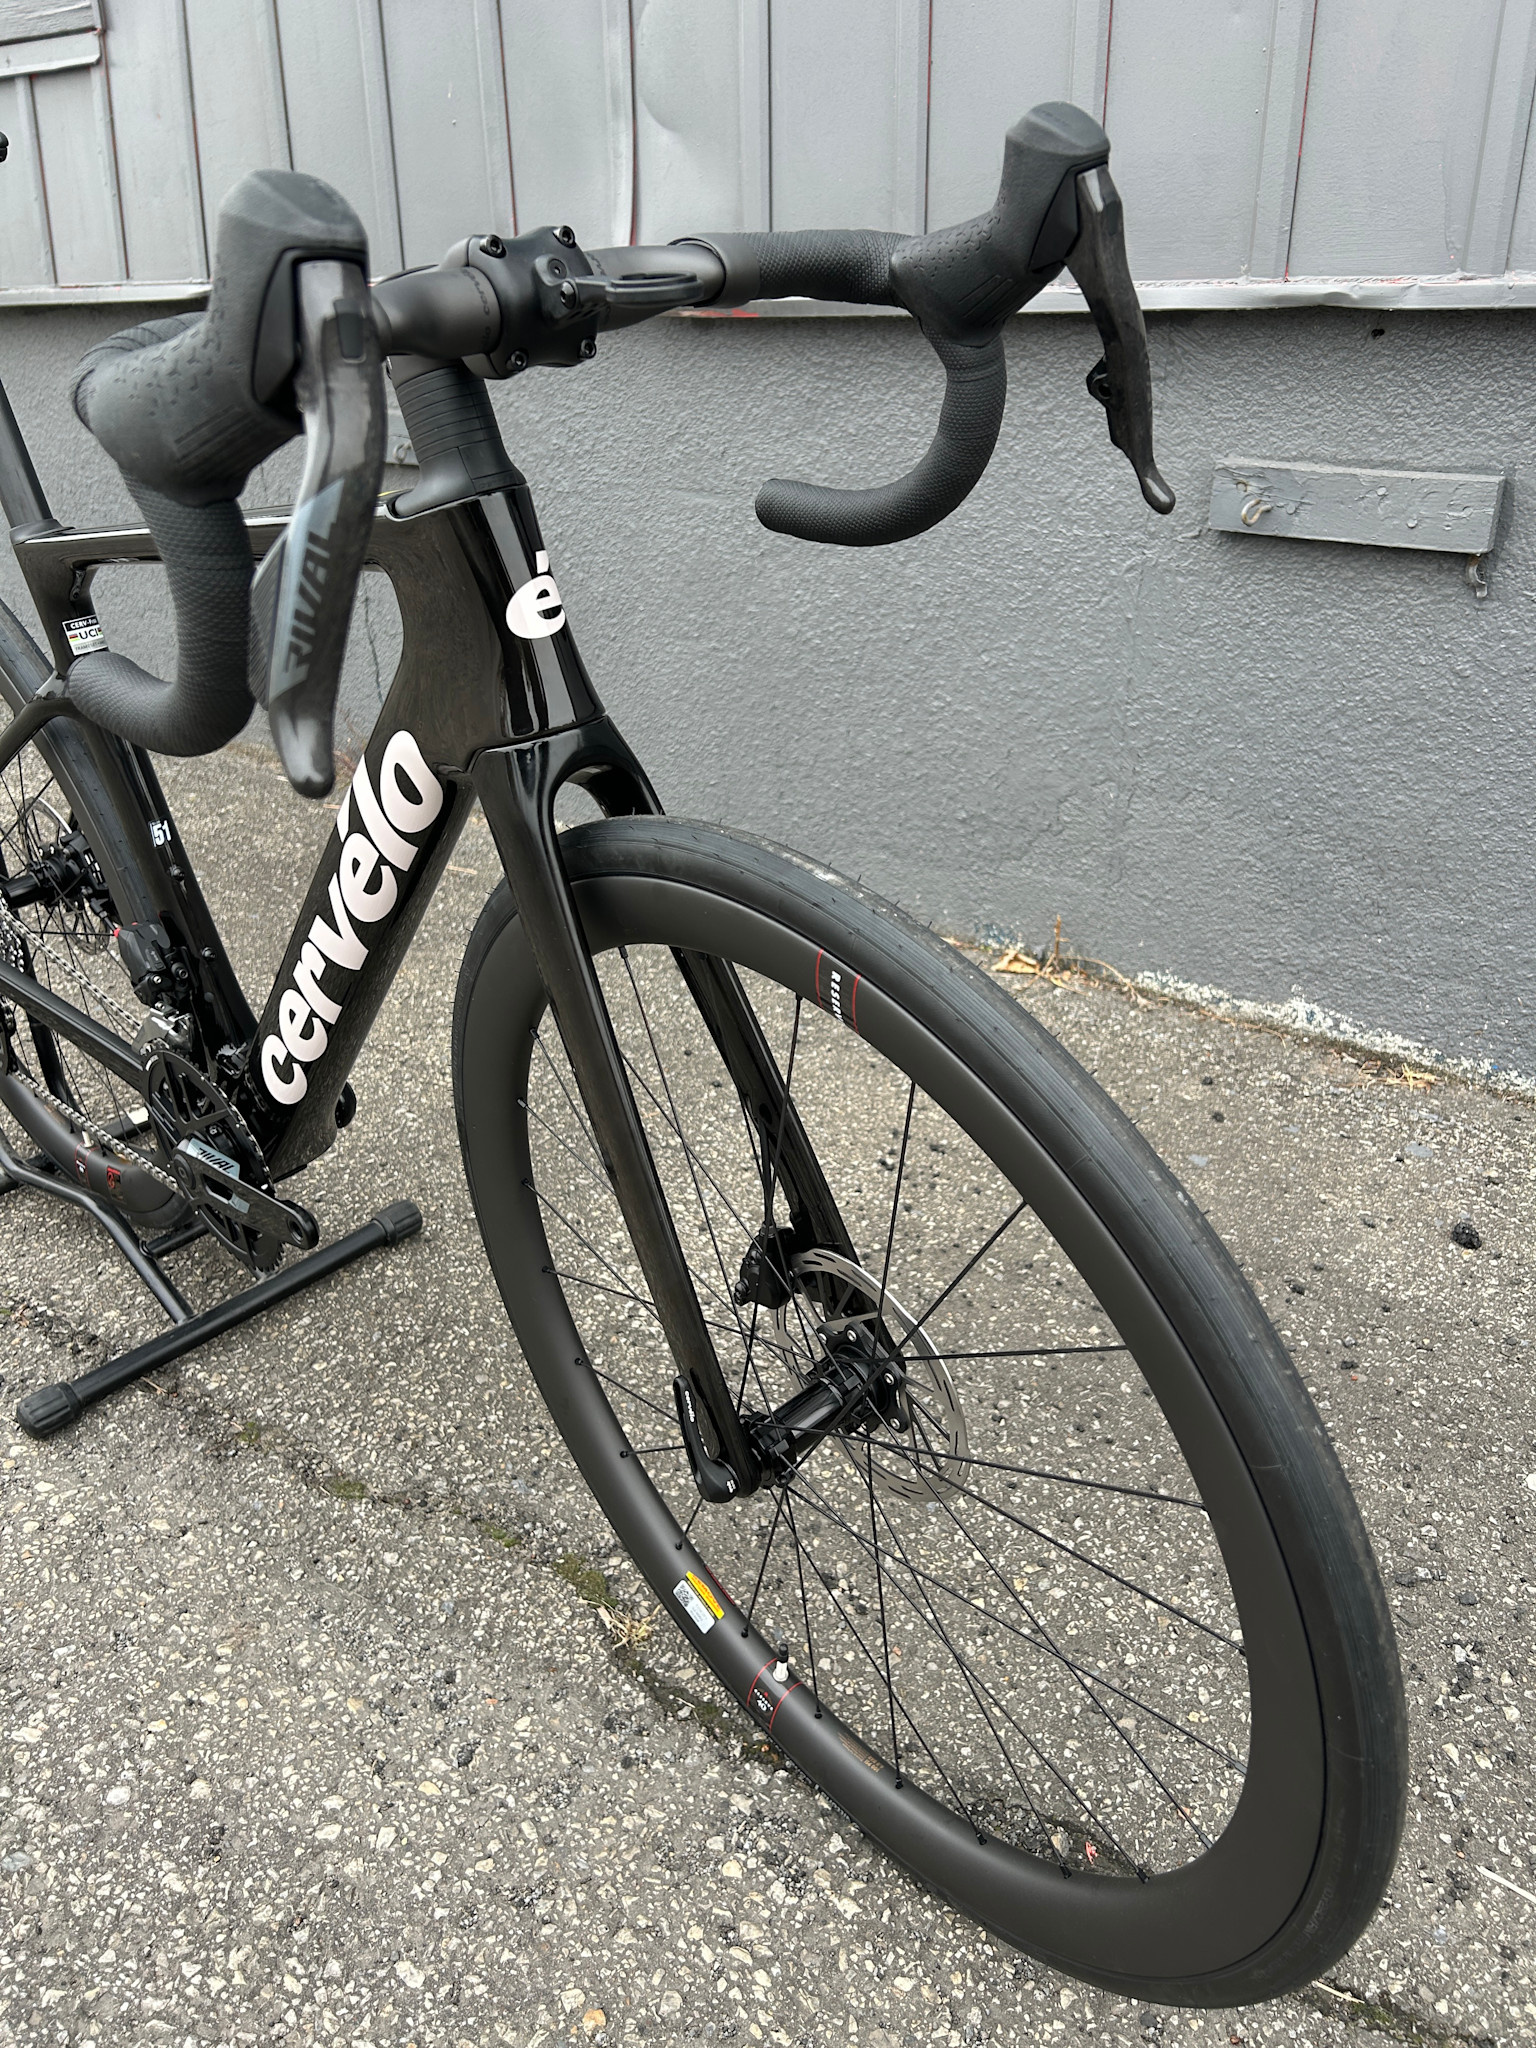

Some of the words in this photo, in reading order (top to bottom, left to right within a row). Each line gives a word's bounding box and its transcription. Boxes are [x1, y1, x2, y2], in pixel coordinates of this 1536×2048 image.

[79, 628, 99, 640] UCI
[285, 521, 336, 674] RIVAL
[153, 820, 171, 846] 51
[261, 729, 444, 1105] cervélo
